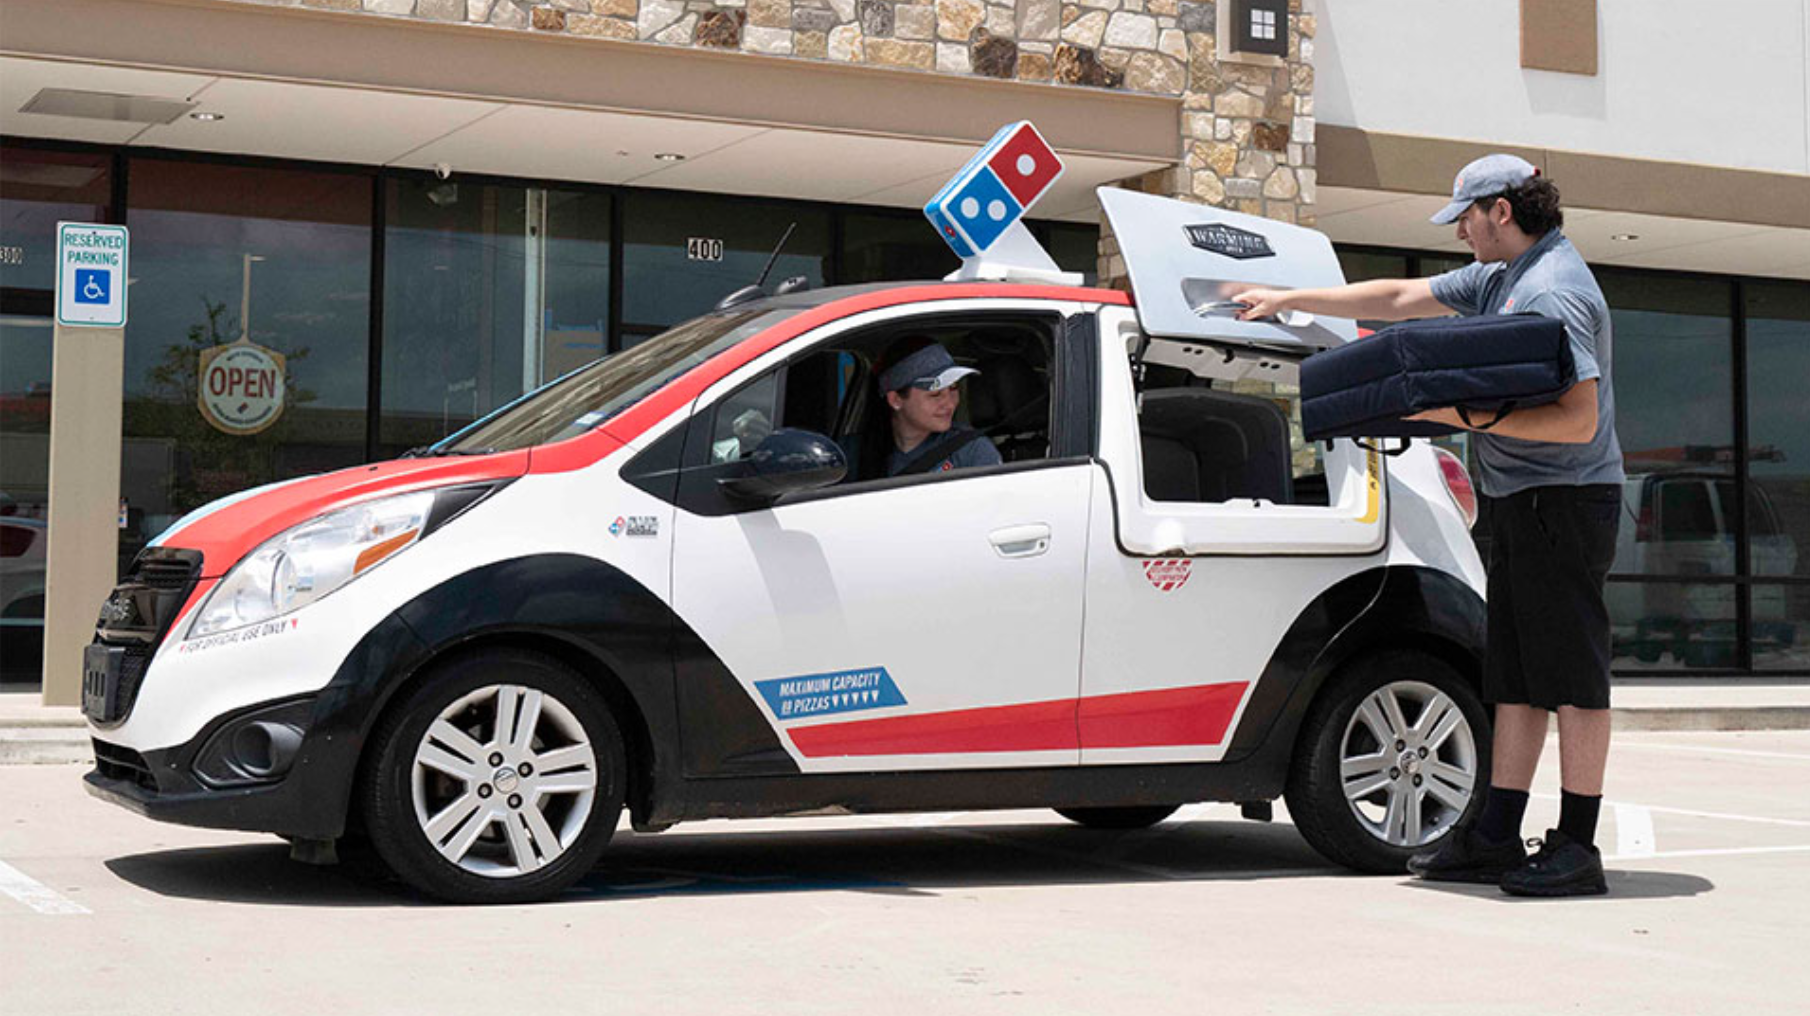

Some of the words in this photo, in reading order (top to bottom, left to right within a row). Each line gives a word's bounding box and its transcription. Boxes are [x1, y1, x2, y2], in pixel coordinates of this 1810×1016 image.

[65, 233, 123, 250] RESERVED
[689, 239, 722, 259] 400
[67, 250, 119, 266] PARKING
[209, 366, 277, 399] OPEN
[242, 626, 261, 642] USE
[262, 620, 287, 637] ONLY
[779, 678, 831, 698] MAXIMUM
[832, 672, 881, 692] CAPACITY
[793, 695, 830, 714] PIZZAS
